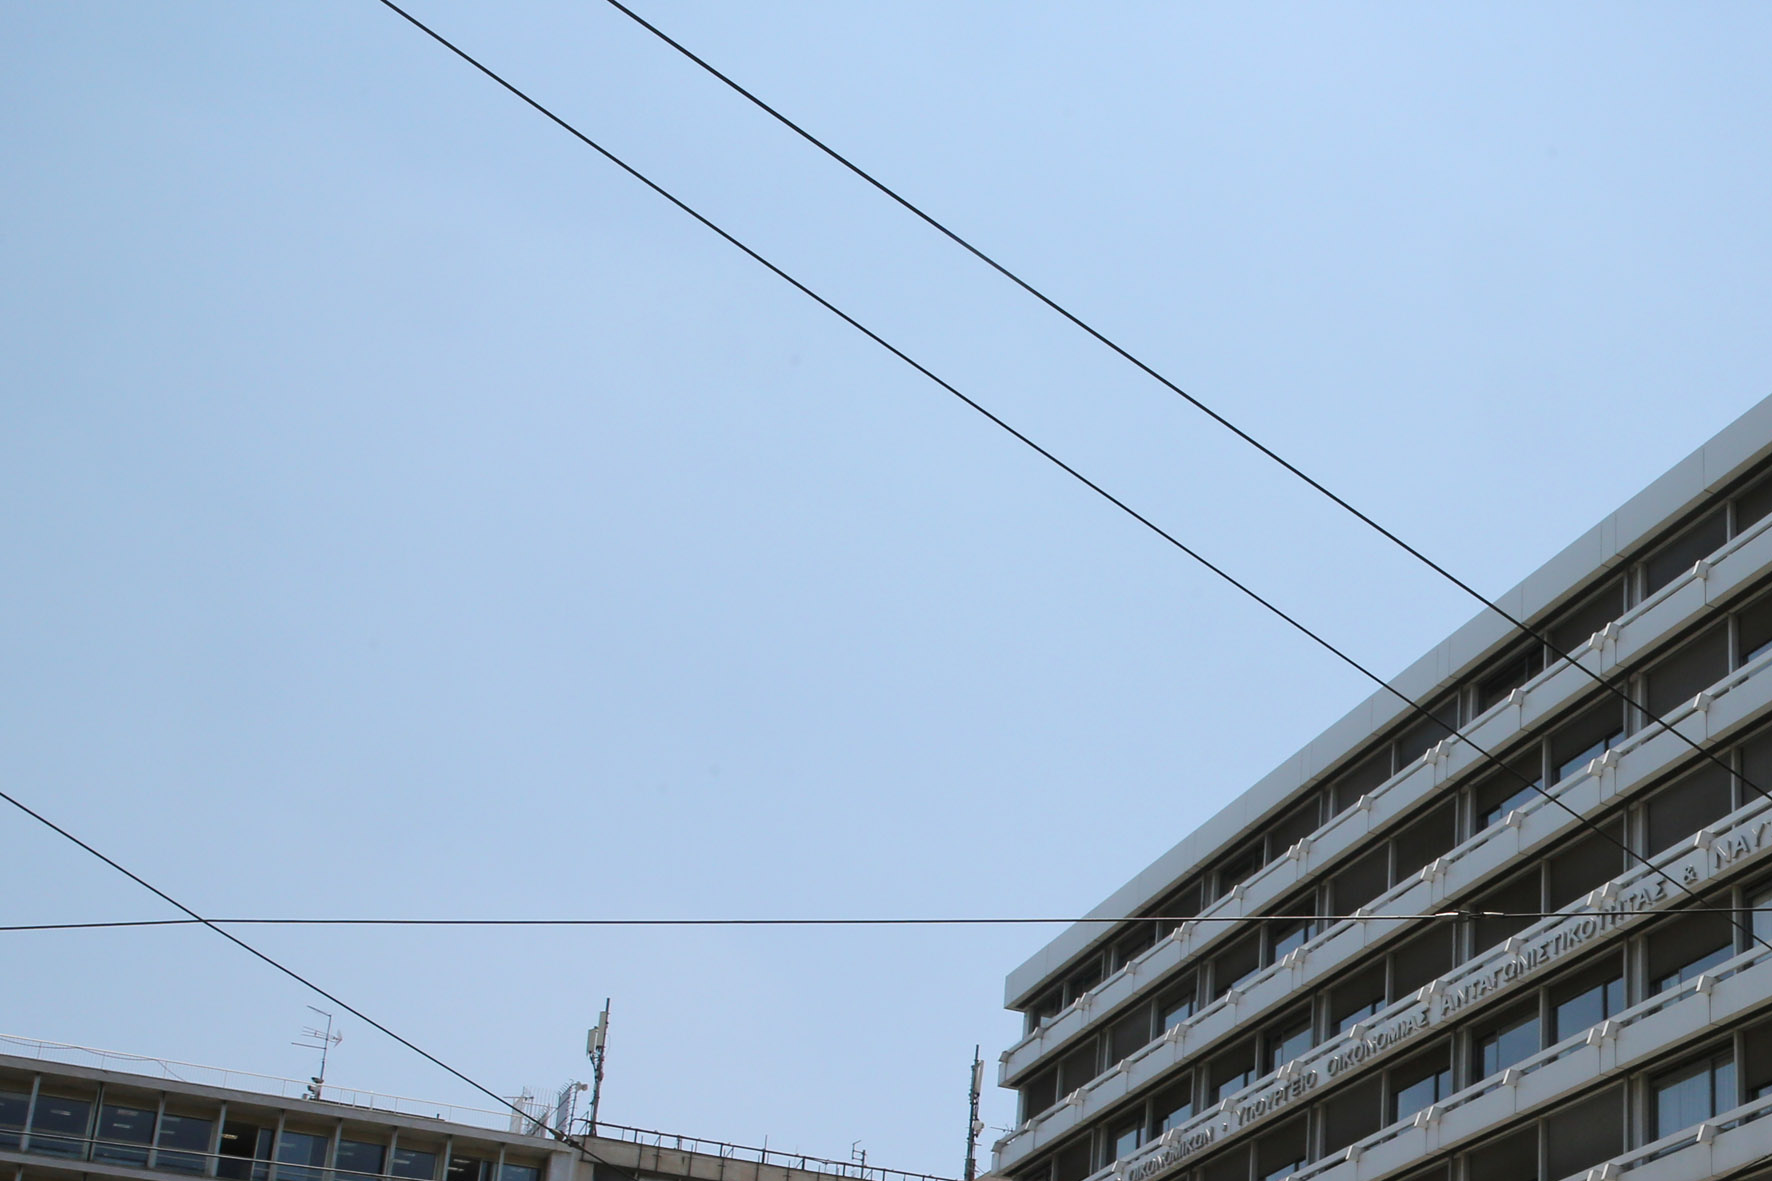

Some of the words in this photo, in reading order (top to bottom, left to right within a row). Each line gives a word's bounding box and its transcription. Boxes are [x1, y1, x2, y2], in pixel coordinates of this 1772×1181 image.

[1235, 1068, 1318, 1127] ΥΠΟΥΡΓΕΙΟ
[1327, 1009, 1430, 1078] ΟΙΚΟΝΟΜΙΑΣ
[1440, 877, 1668, 1017] ΑΝΤΑΓΩΝΙΣΤΙΚΟΤΗΤΑΣ
[1683, 864, 1698, 884] &
